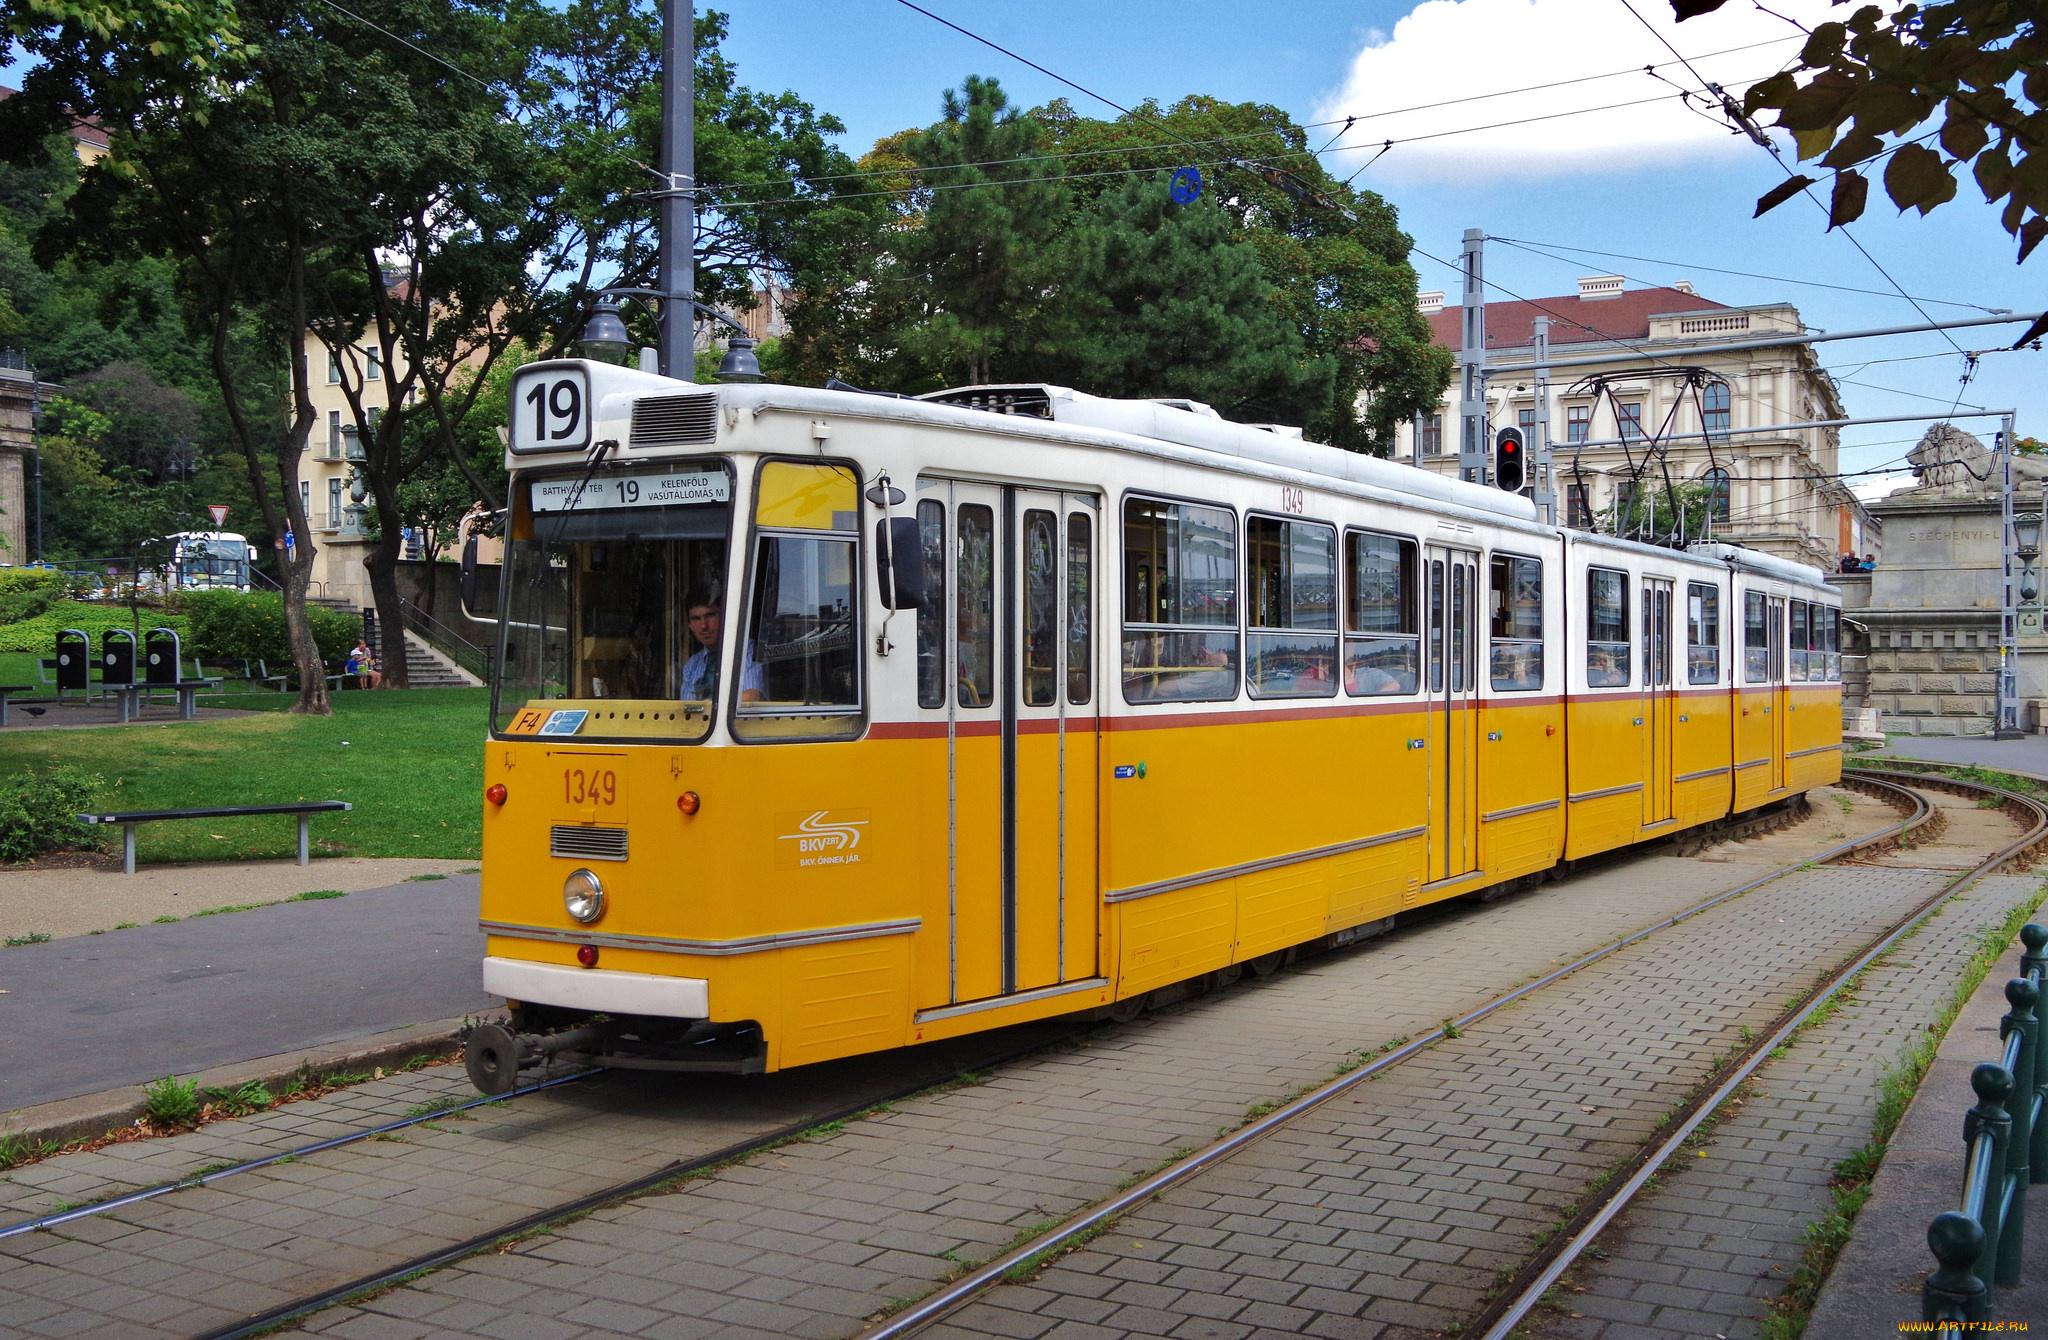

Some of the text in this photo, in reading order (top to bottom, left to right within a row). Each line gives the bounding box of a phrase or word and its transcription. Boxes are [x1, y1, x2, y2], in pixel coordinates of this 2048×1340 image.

[526, 379, 581, 441] 19
[589, 482, 603, 493] TÉR
[616, 480, 639, 503] 19
[648, 488, 724, 500] VASÚTÁLLOMÁS M
[1282, 486, 1303, 514] 1349
[515, 712, 541, 731] F4
[564, 769, 616, 806] 1349
